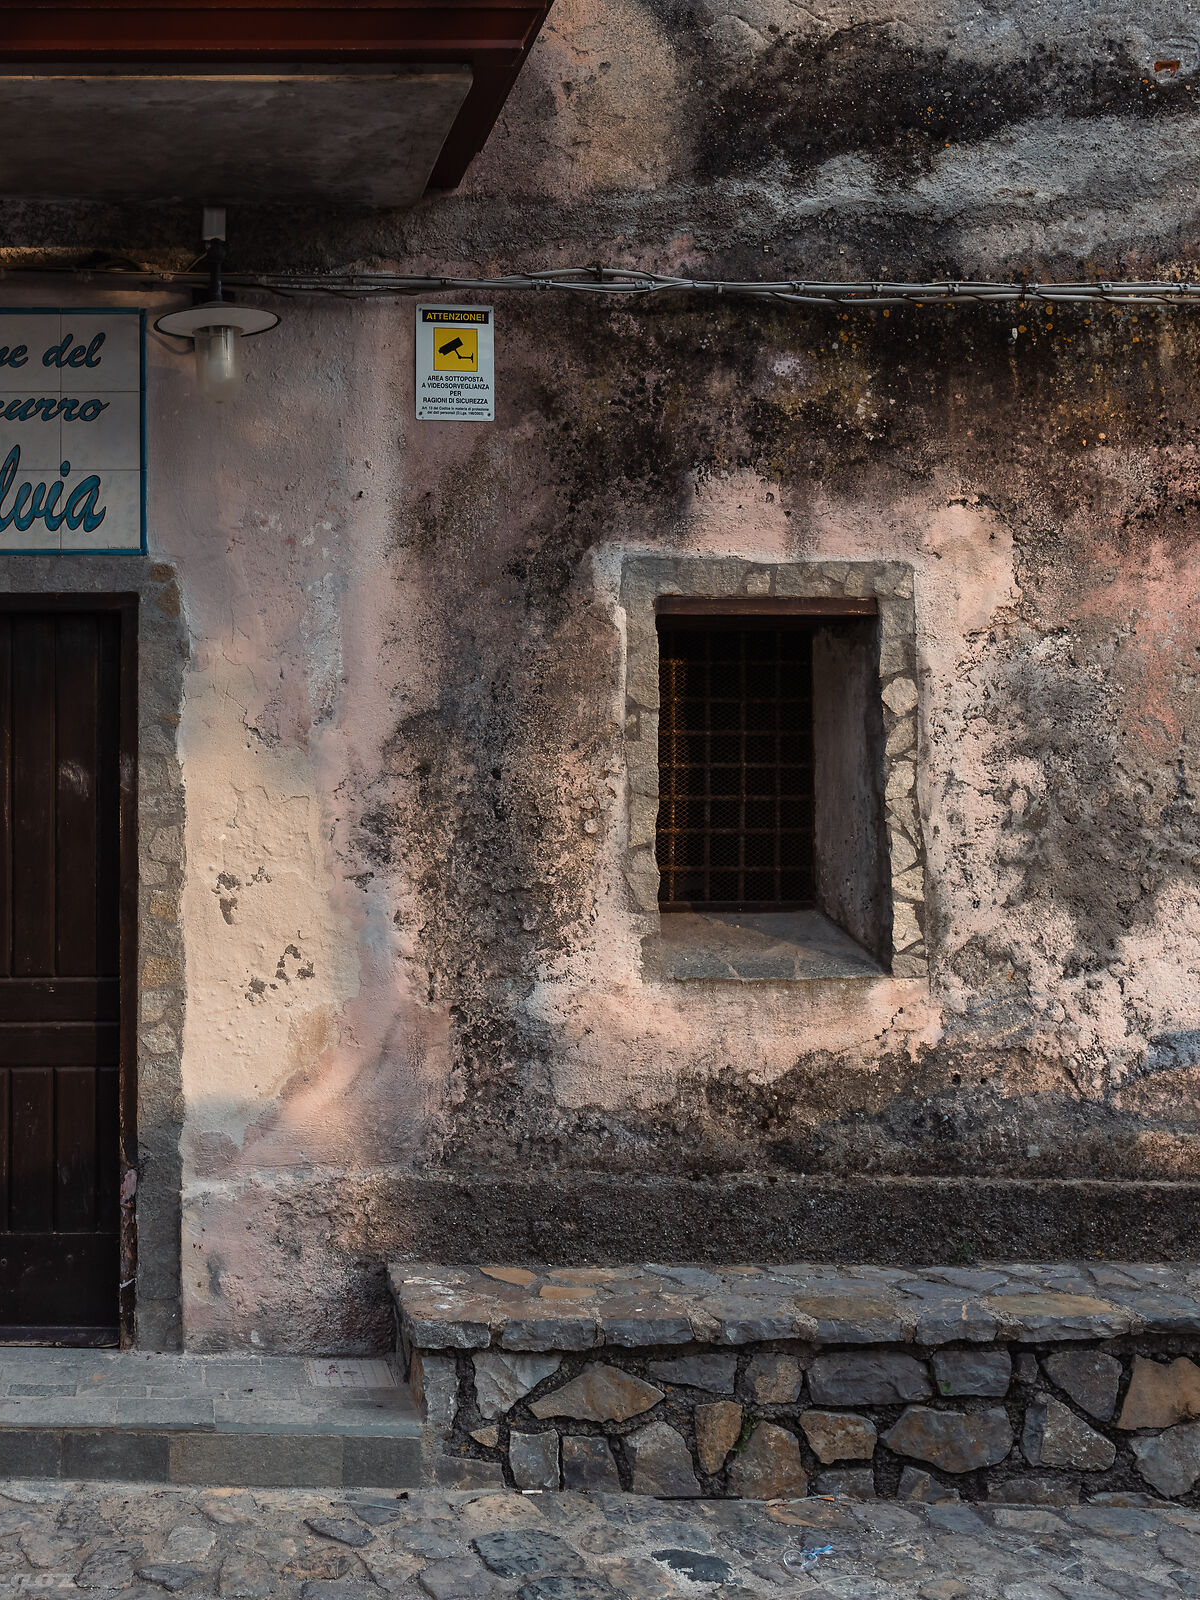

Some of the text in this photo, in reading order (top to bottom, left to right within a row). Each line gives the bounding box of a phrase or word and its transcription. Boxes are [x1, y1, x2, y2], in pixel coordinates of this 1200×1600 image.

[426, 312, 485, 322] ATTENZIONE!
[42, 332, 106, 369] del
[445, 375, 484, 383] SOTTOPOSTA
